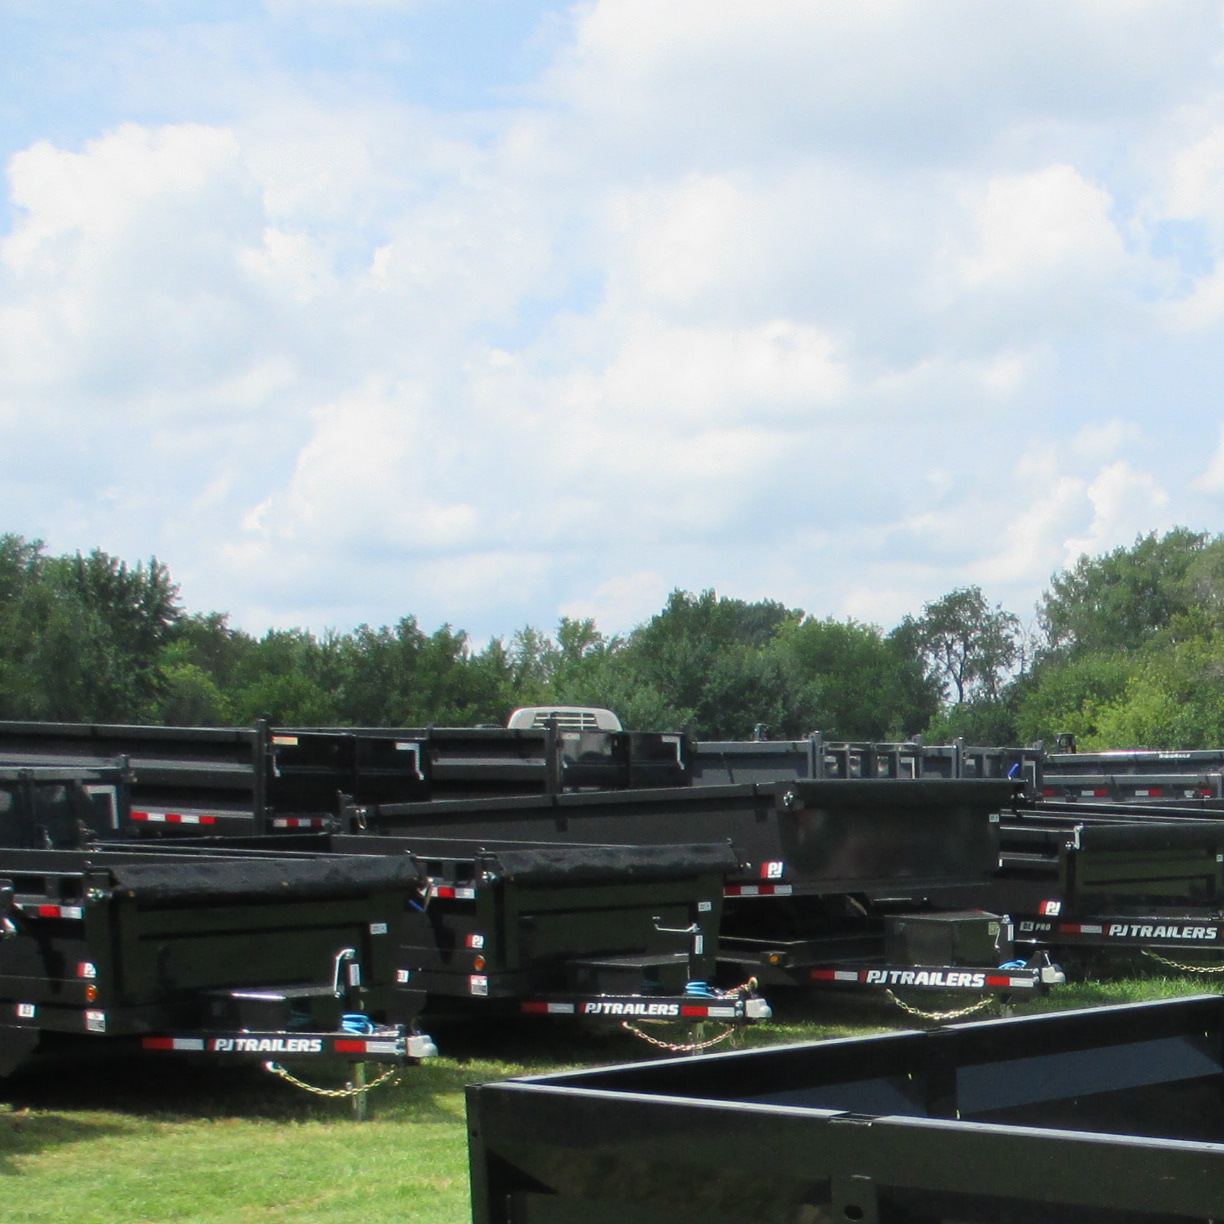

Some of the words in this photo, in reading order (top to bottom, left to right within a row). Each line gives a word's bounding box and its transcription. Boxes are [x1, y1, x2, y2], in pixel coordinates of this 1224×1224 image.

[767, 861, 784, 876] PJ
[1130, 924, 1217, 939] TRAILERS
[890, 970, 986, 987] TRAILERS
[603, 1003, 680, 1016] TRAILERS
[235, 1038, 322, 1052] TRAILERS
